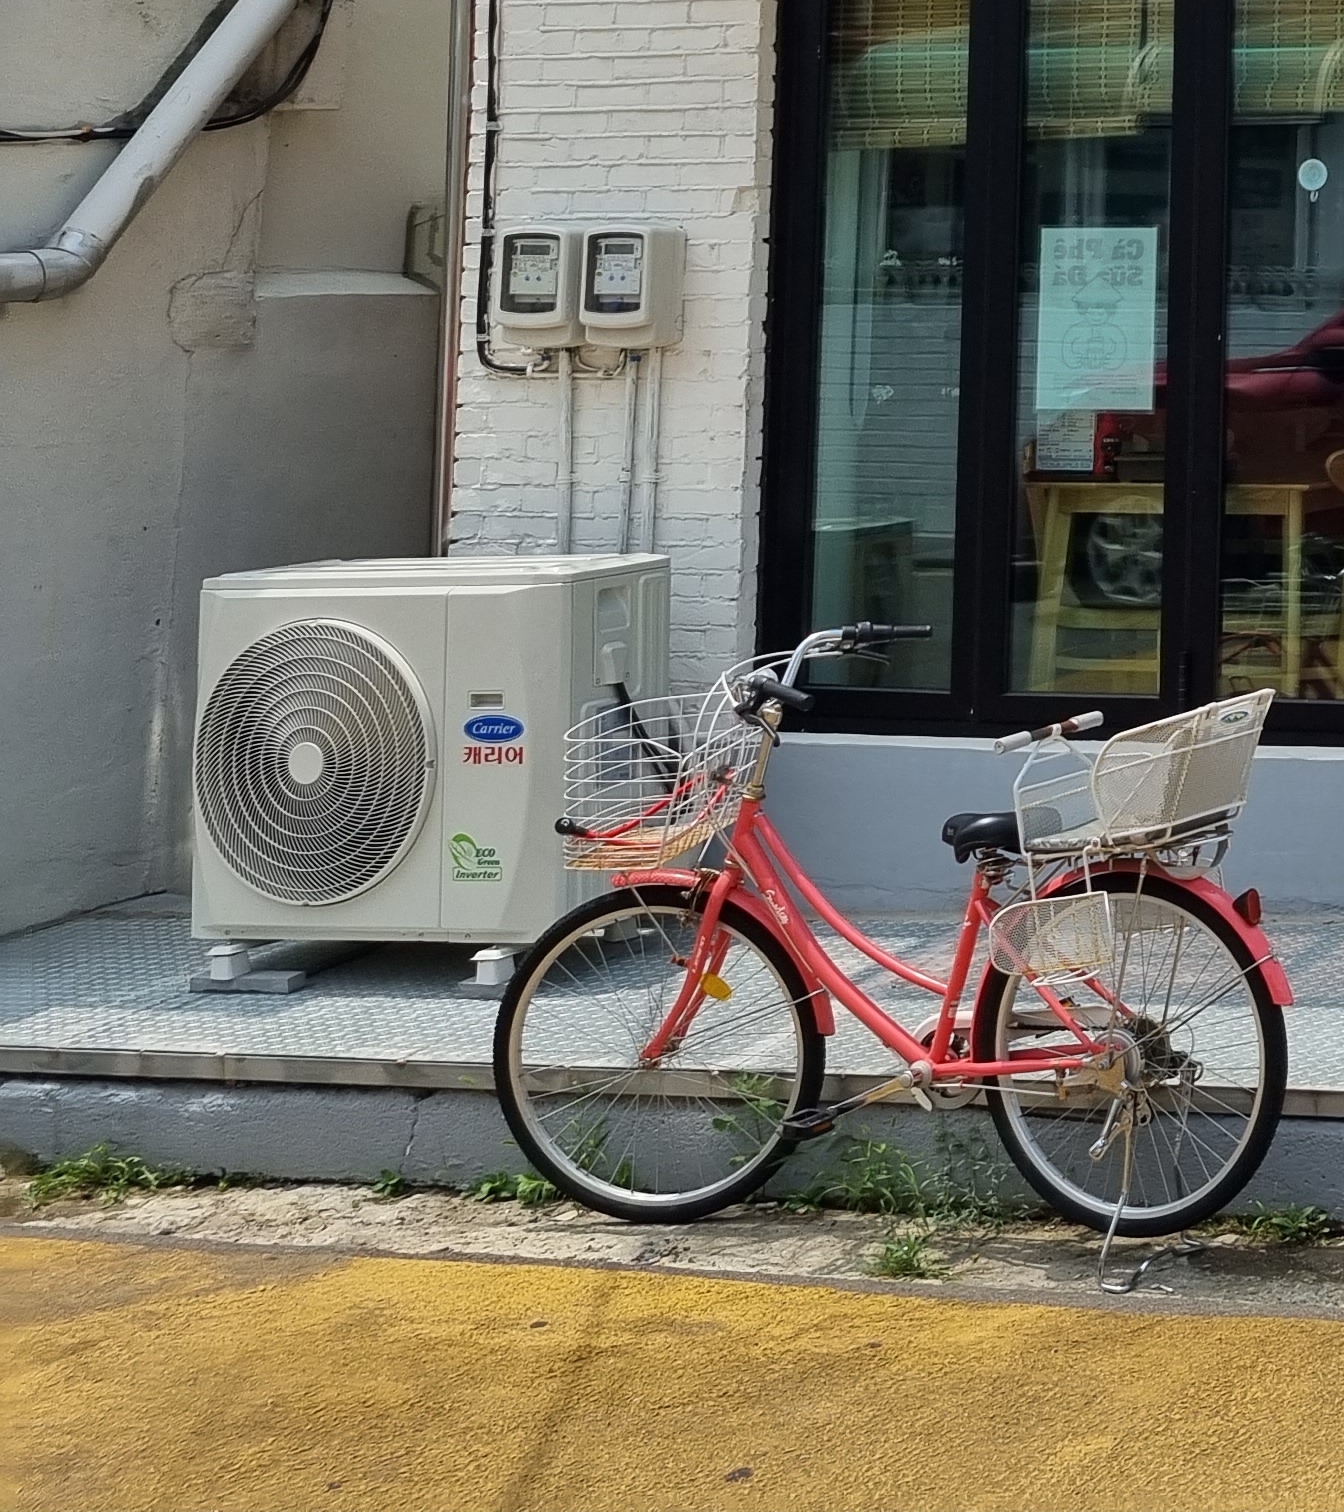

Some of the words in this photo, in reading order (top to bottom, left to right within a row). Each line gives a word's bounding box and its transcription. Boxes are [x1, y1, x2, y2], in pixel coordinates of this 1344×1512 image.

[472, 721, 516, 735] Carrier
[462, 746, 524, 765] 캐리어
[475, 847, 496, 858] ECO
[455, 869, 500, 880] Inverter
